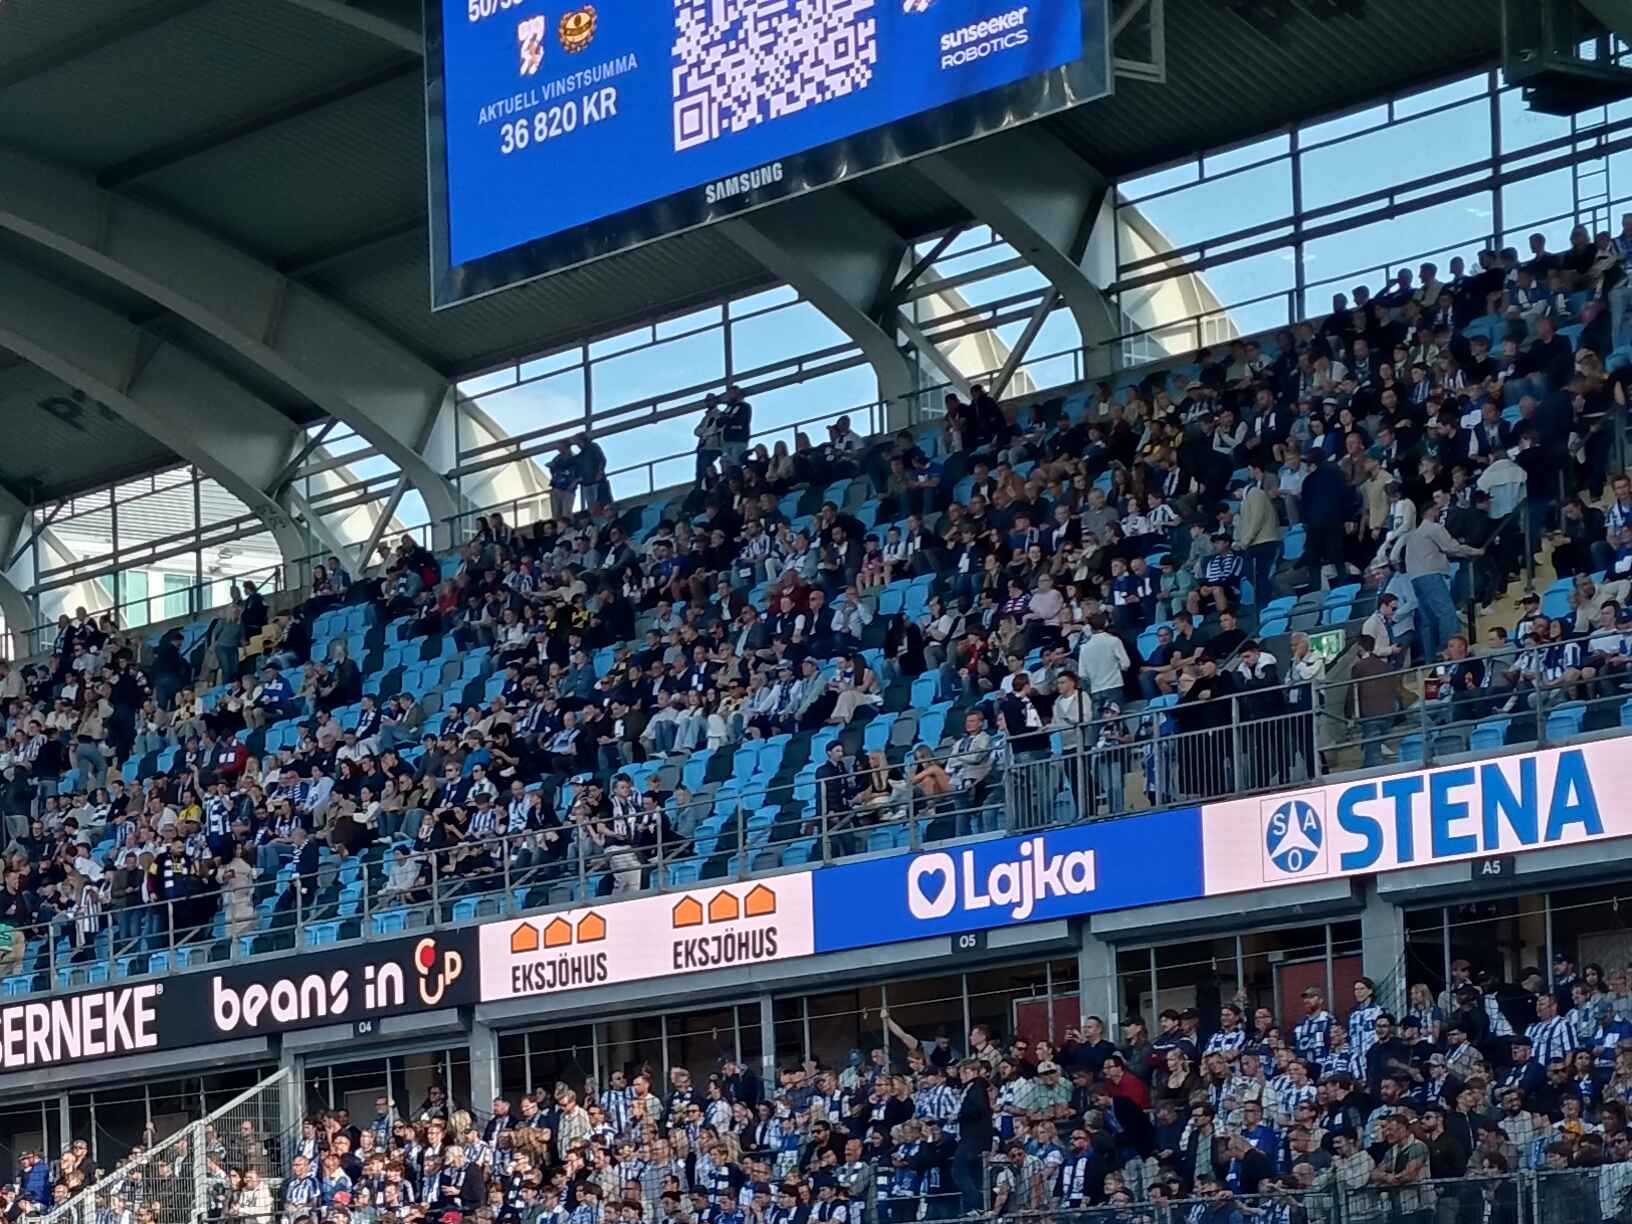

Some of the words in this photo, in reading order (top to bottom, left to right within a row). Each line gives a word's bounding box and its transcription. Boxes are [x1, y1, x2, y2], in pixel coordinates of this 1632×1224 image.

[468, 0, 524, 22] 50/
[940, 7, 1029, 50] sunseeker
[941, 29, 1029, 70] ROBOTICS
[478, 89, 540, 125] AKTUELL
[541, 52, 638, 101] VINSTSUMMA
[500, 118, 529, 154] 36
[533, 100, 577, 143] 820
[582, 86, 617, 125] KR
[705, 162, 783, 204] SAMSUNG
[1337, 749, 1605, 871] STENA
[963, 836, 1096, 920] Lajka
[1481, 860, 1502, 876] A5
[673, 926, 778, 970] EKSJÖHUS
[511, 953, 609, 993] EKSJÖHUS
[213, 970, 349, 1032] beans
[365, 961, 405, 1009] in
